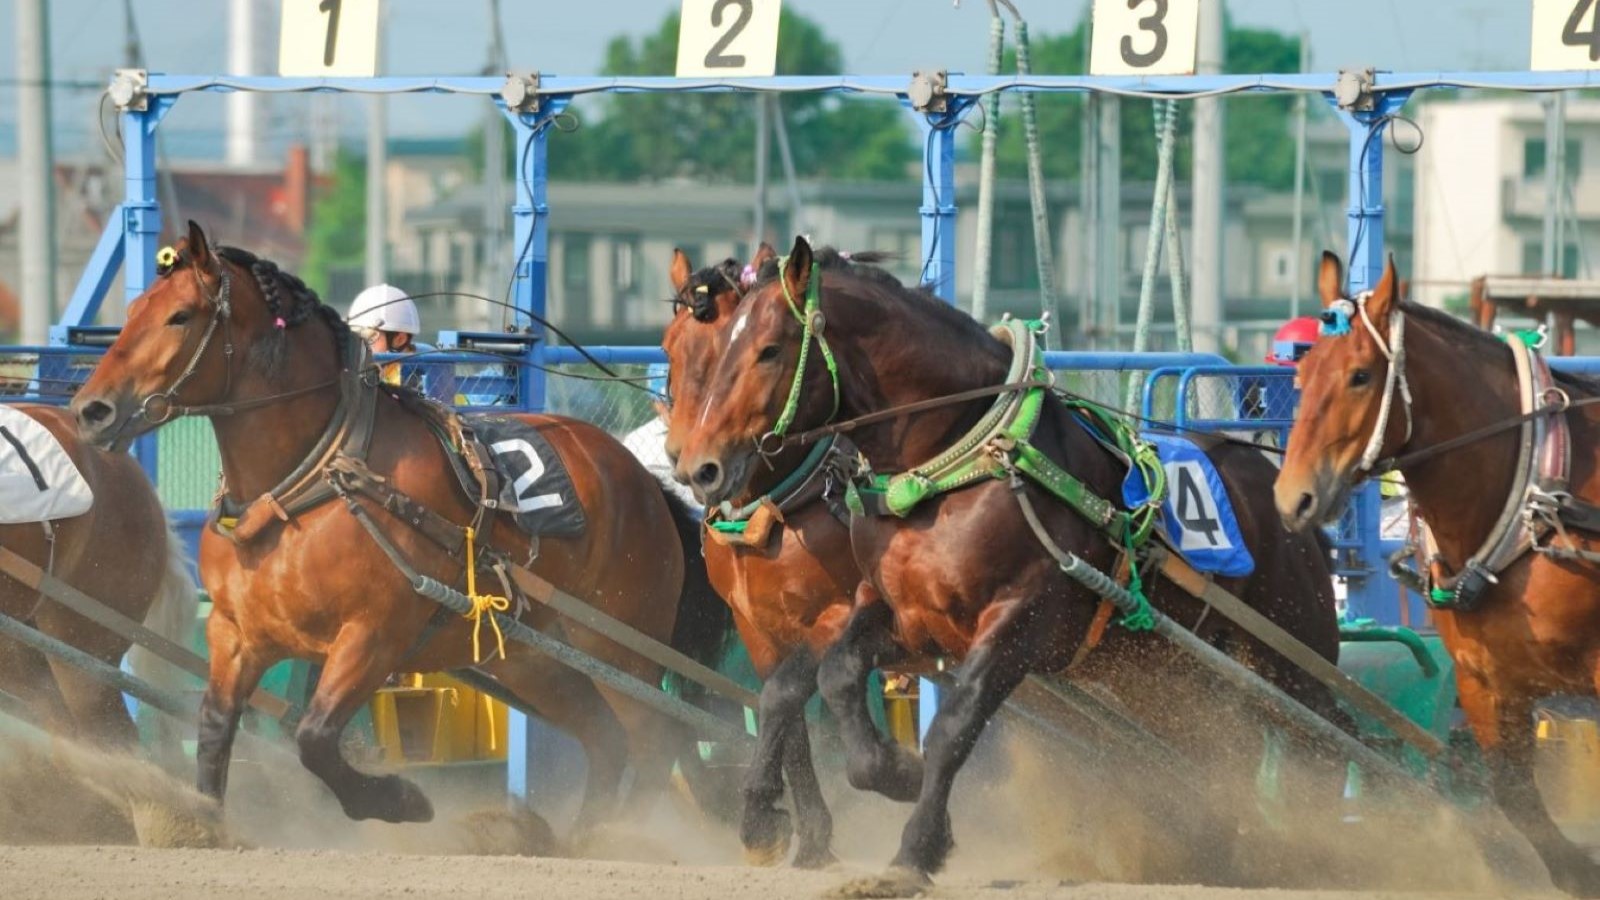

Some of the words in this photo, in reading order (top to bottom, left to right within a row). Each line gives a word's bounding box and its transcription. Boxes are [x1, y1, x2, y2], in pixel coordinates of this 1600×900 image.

[319, 0, 341, 67] 1
[704, 0, 753, 68] 2
[1120, 0, 1168, 68] 3
[1562, 0, 1600, 62] 4
[0, 425, 49, 491] 1
[490, 438, 563, 513] 2
[1177, 466, 1219, 546] 4
